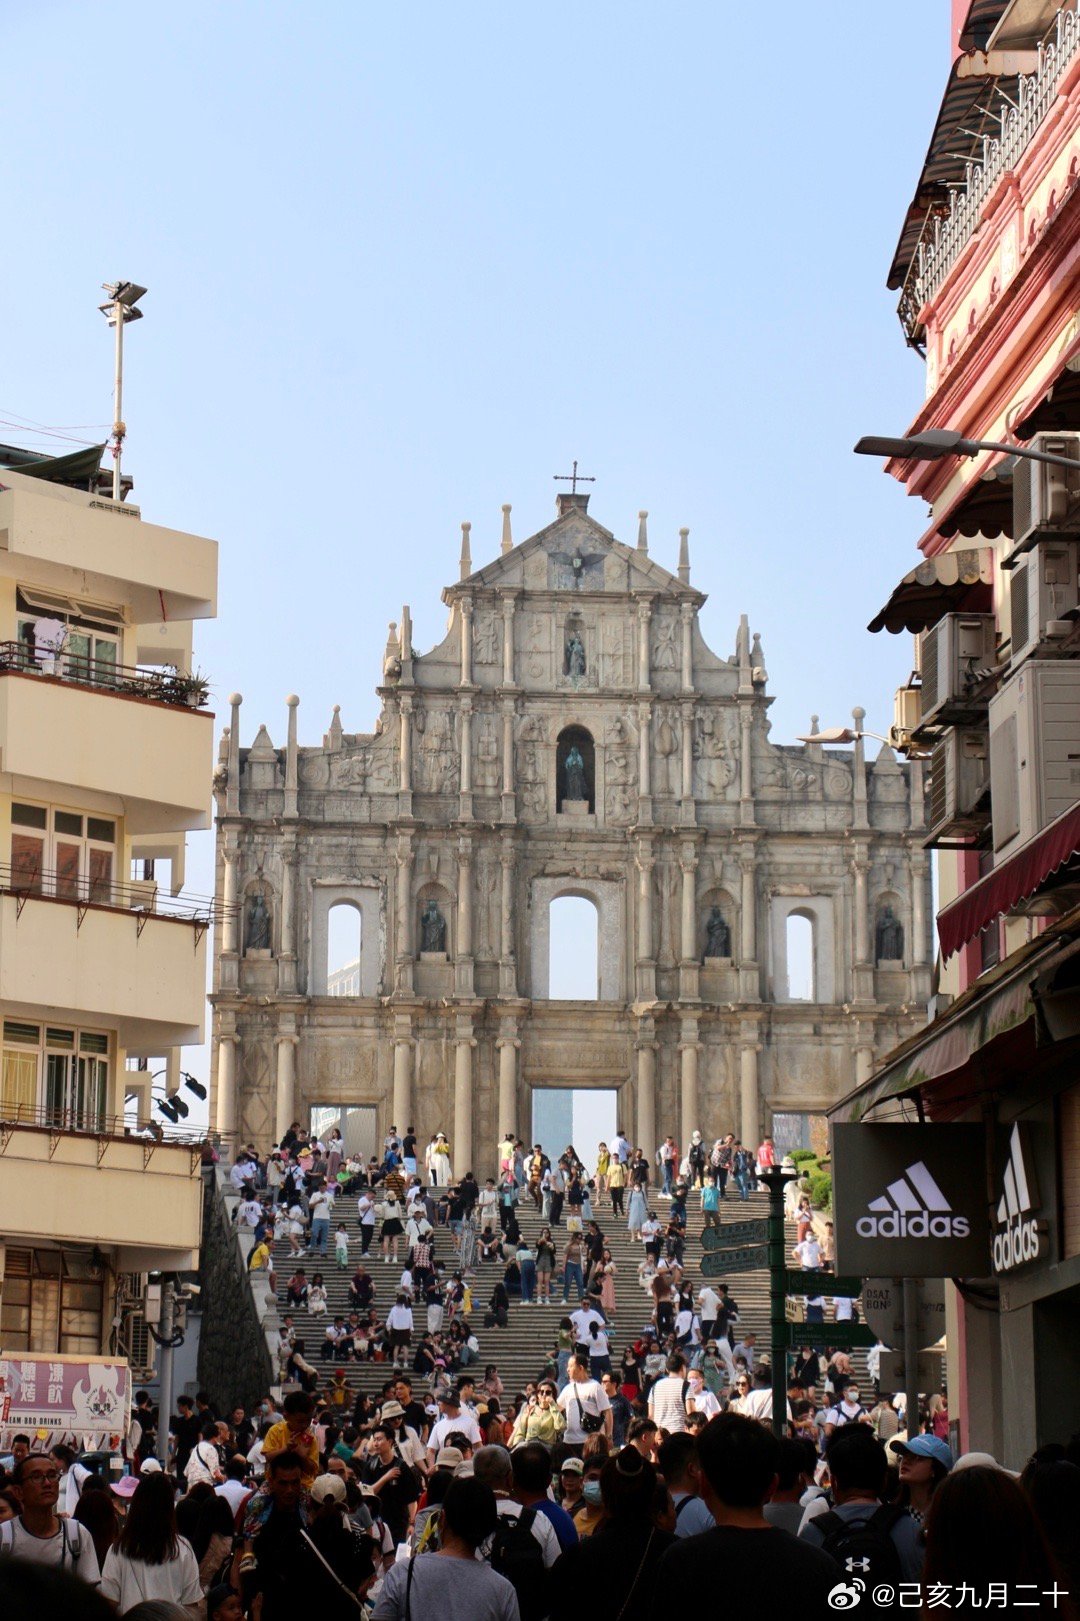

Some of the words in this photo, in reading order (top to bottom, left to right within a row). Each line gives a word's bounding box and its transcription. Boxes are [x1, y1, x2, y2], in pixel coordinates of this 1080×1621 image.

[856, 1211, 970, 1238] adidas
[994, 1213, 1039, 1272] adidas
[6, 1416, 21, 1424] EAM
[24, 1416, 37, 1425] BBQ
[39, 1417, 62, 1426] DRINKS
